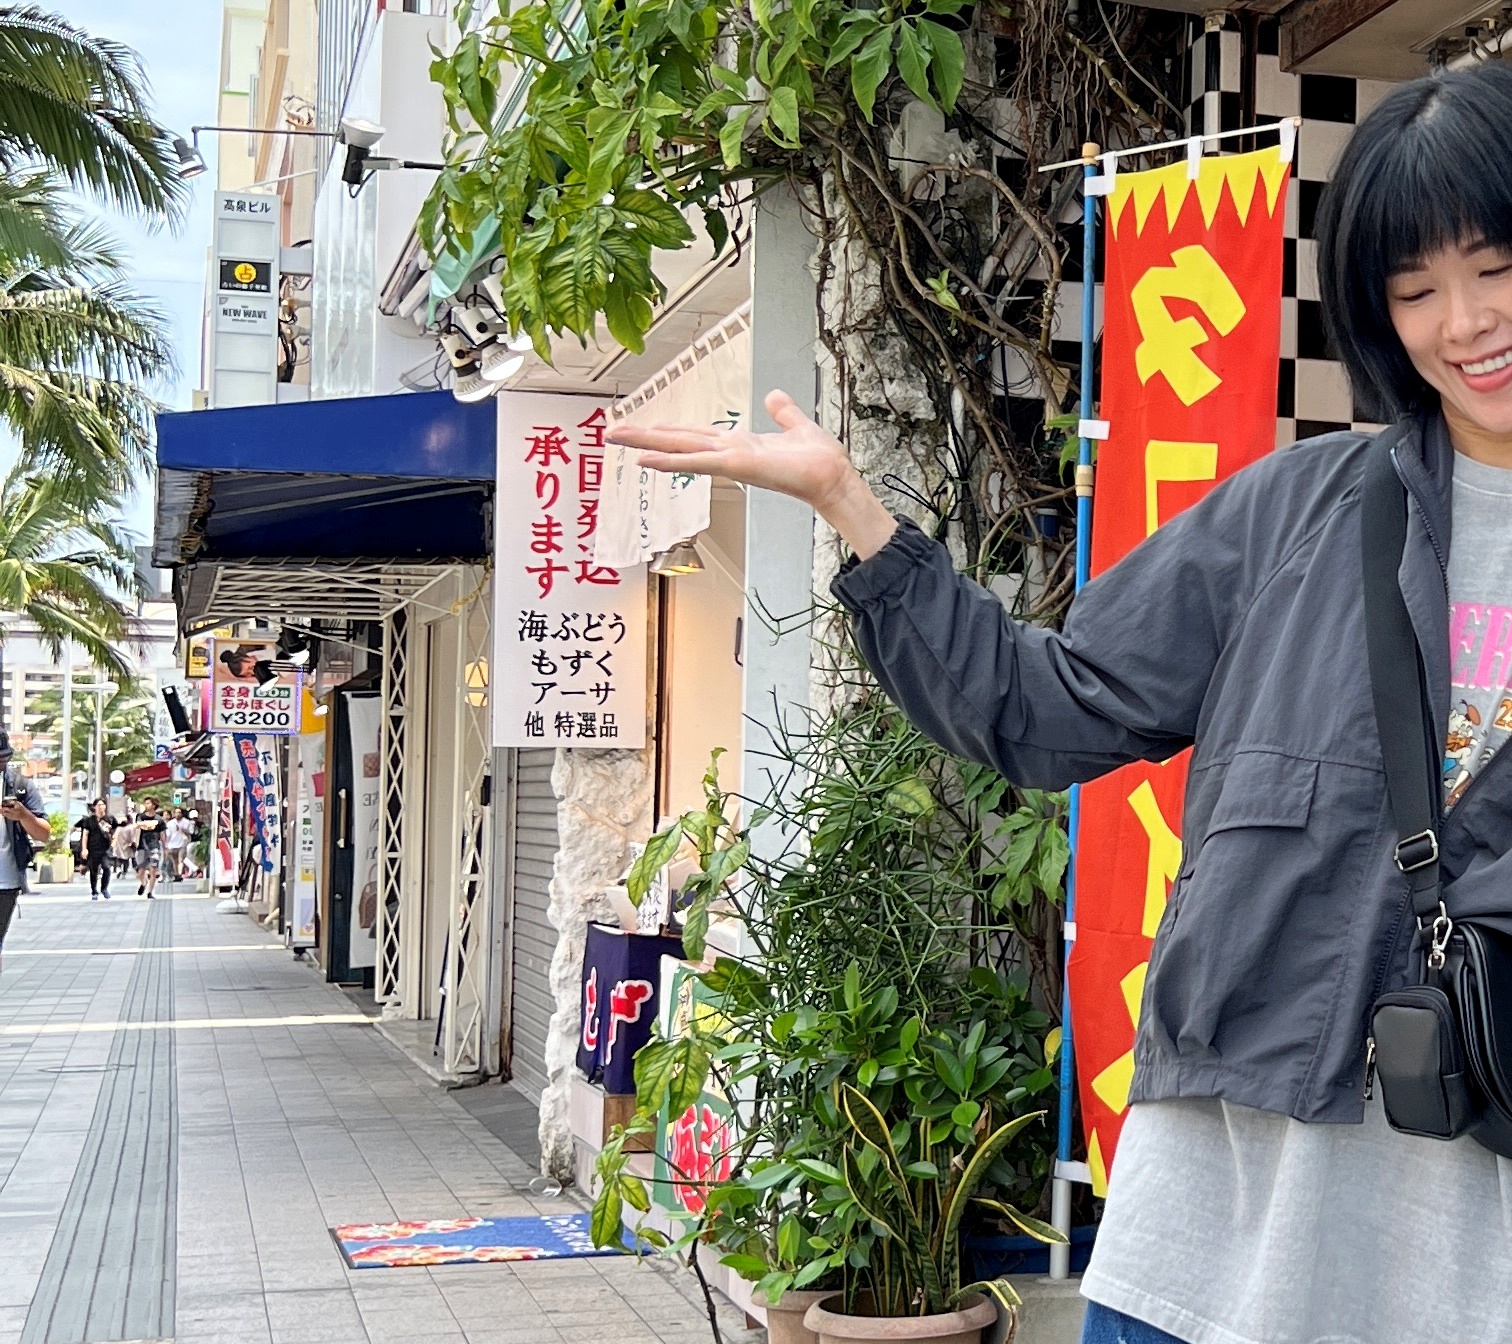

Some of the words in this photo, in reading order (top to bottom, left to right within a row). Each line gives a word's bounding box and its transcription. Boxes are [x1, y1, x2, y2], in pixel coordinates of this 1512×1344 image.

[222, 307, 242, 318] NEW
[243, 309, 267, 320] WAVE
[524, 425, 572, 600] 承ります
[518, 610, 627, 643] 海ぶどう
[531, 649, 615, 677] もずく
[221, 685, 250, 698] 全身
[531, 682, 616, 706] アーサ
[221, 699, 290, 710] もみほぐし
[221, 712, 289, 725] ¥3200
[524, 710, 546, 739] 他
[554, 710, 619, 739] 特選品
